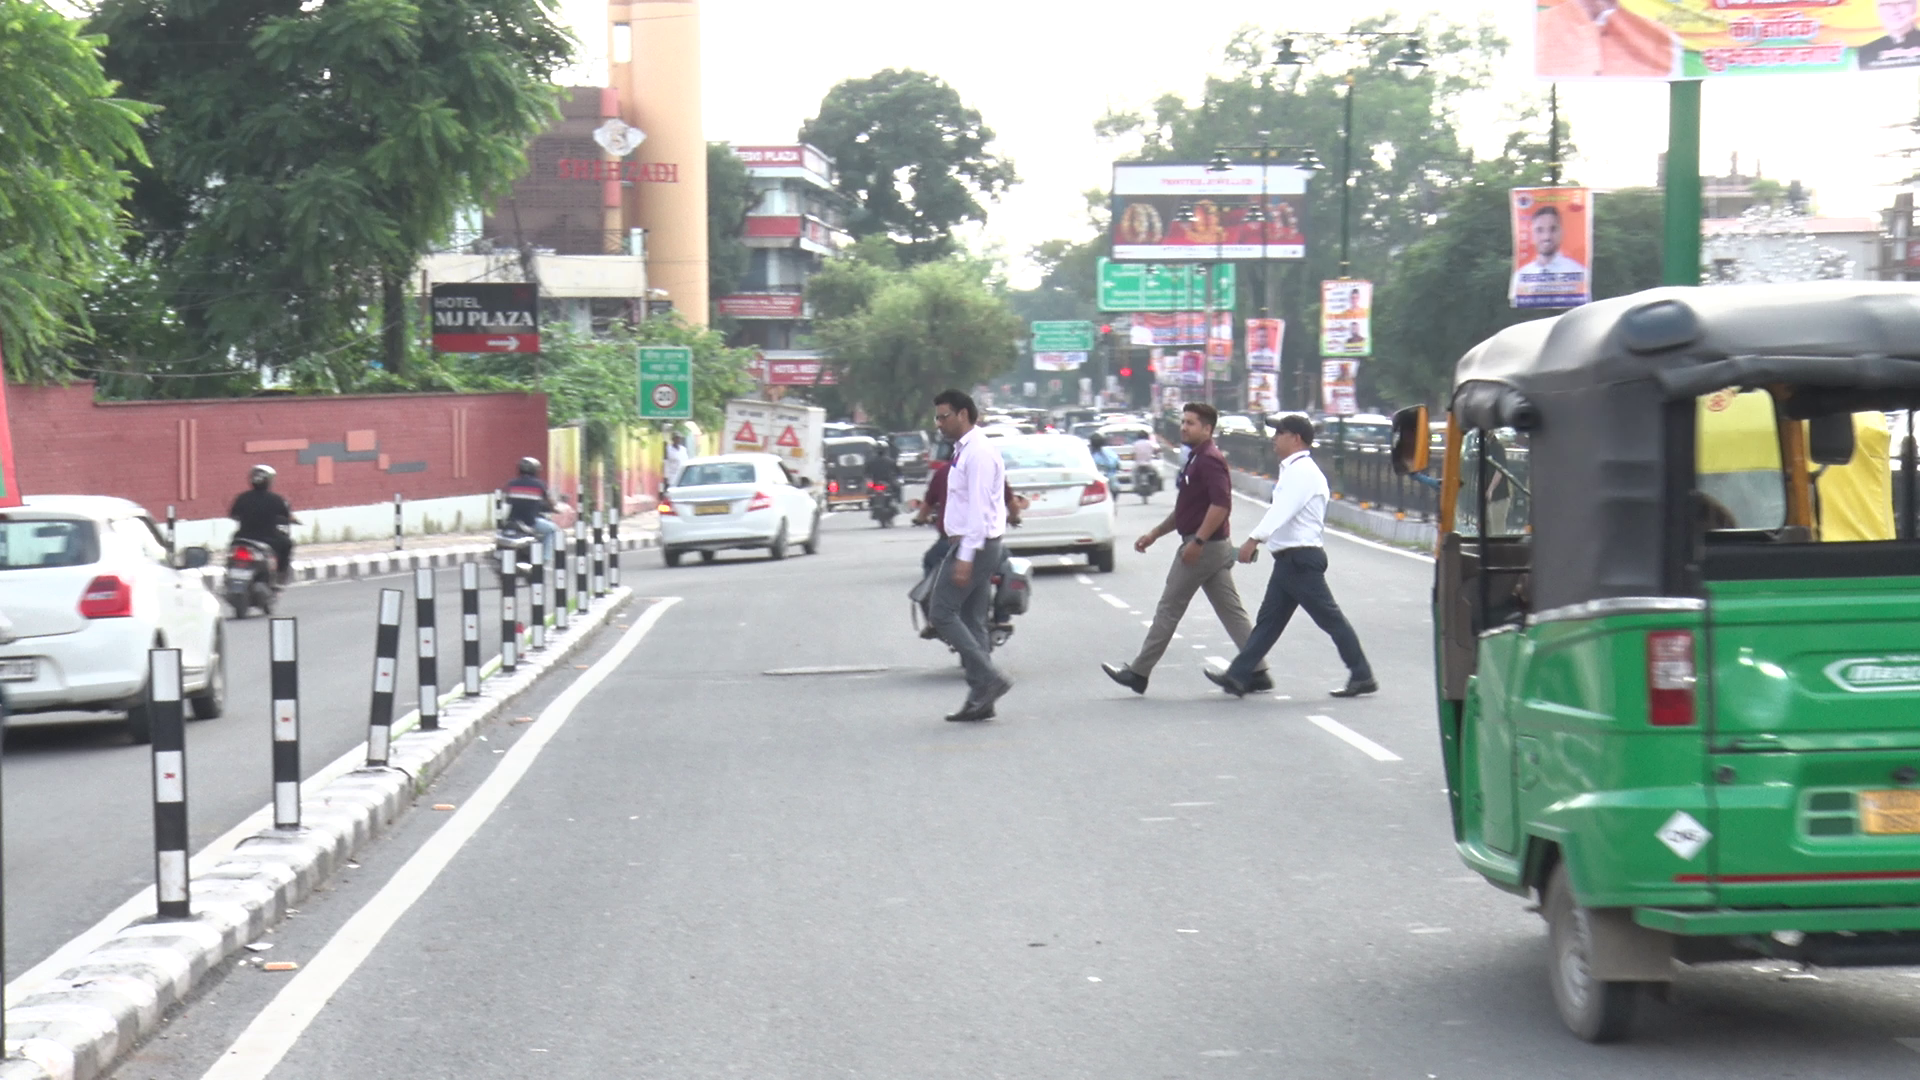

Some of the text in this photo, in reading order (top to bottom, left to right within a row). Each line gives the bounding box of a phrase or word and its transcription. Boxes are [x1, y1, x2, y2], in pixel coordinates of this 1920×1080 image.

[558, 158, 679, 183] SHEHZADI
[434, 296, 483, 309] HOTEL
[435, 311, 534, 327] MJ PLAZA
[658, 390, 671, 402] 20
